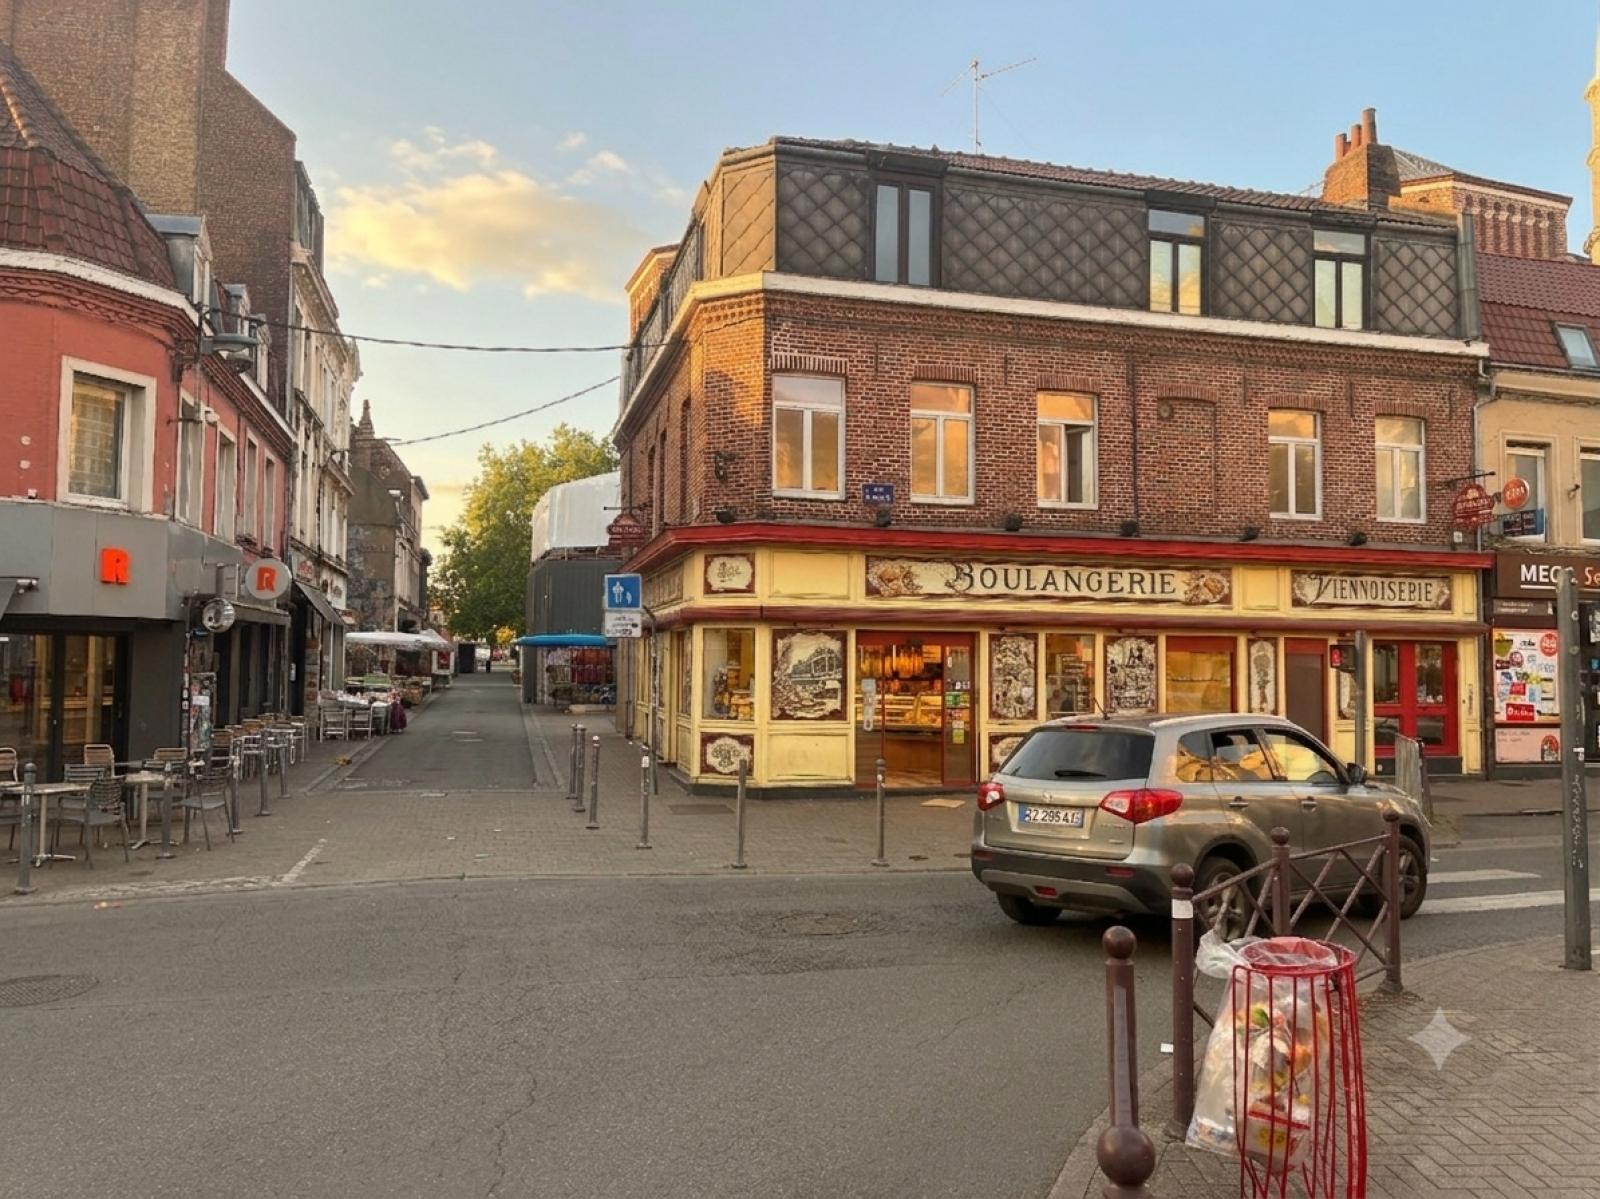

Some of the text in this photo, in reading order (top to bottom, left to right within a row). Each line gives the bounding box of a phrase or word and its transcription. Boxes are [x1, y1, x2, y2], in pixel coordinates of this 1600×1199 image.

[101, 547, 130, 585] R
[256, 566, 276, 593] R
[946, 561, 1176, 595] BOULANGERIE
